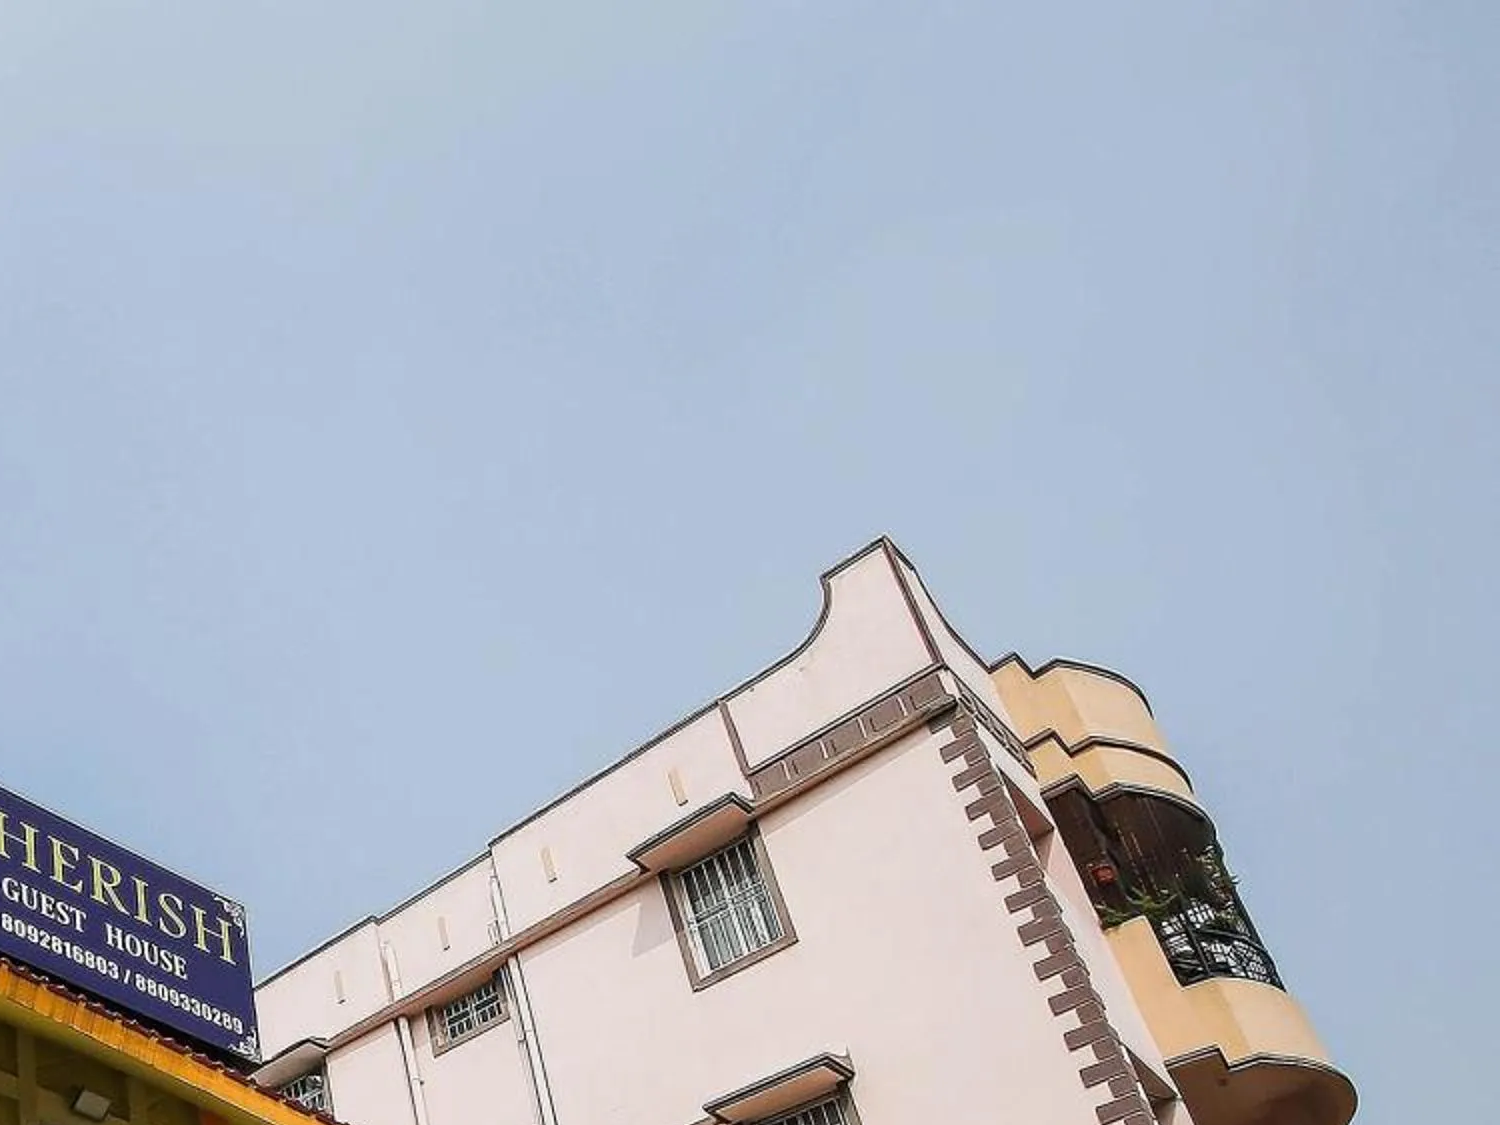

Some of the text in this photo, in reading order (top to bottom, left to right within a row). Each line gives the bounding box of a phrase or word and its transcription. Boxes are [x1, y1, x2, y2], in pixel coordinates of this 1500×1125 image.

[1, 876, 188, 980] GUEST HOUSE
[1, 913, 119, 980] 8092816803
[135, 973, 243, 1035] 8809330289
